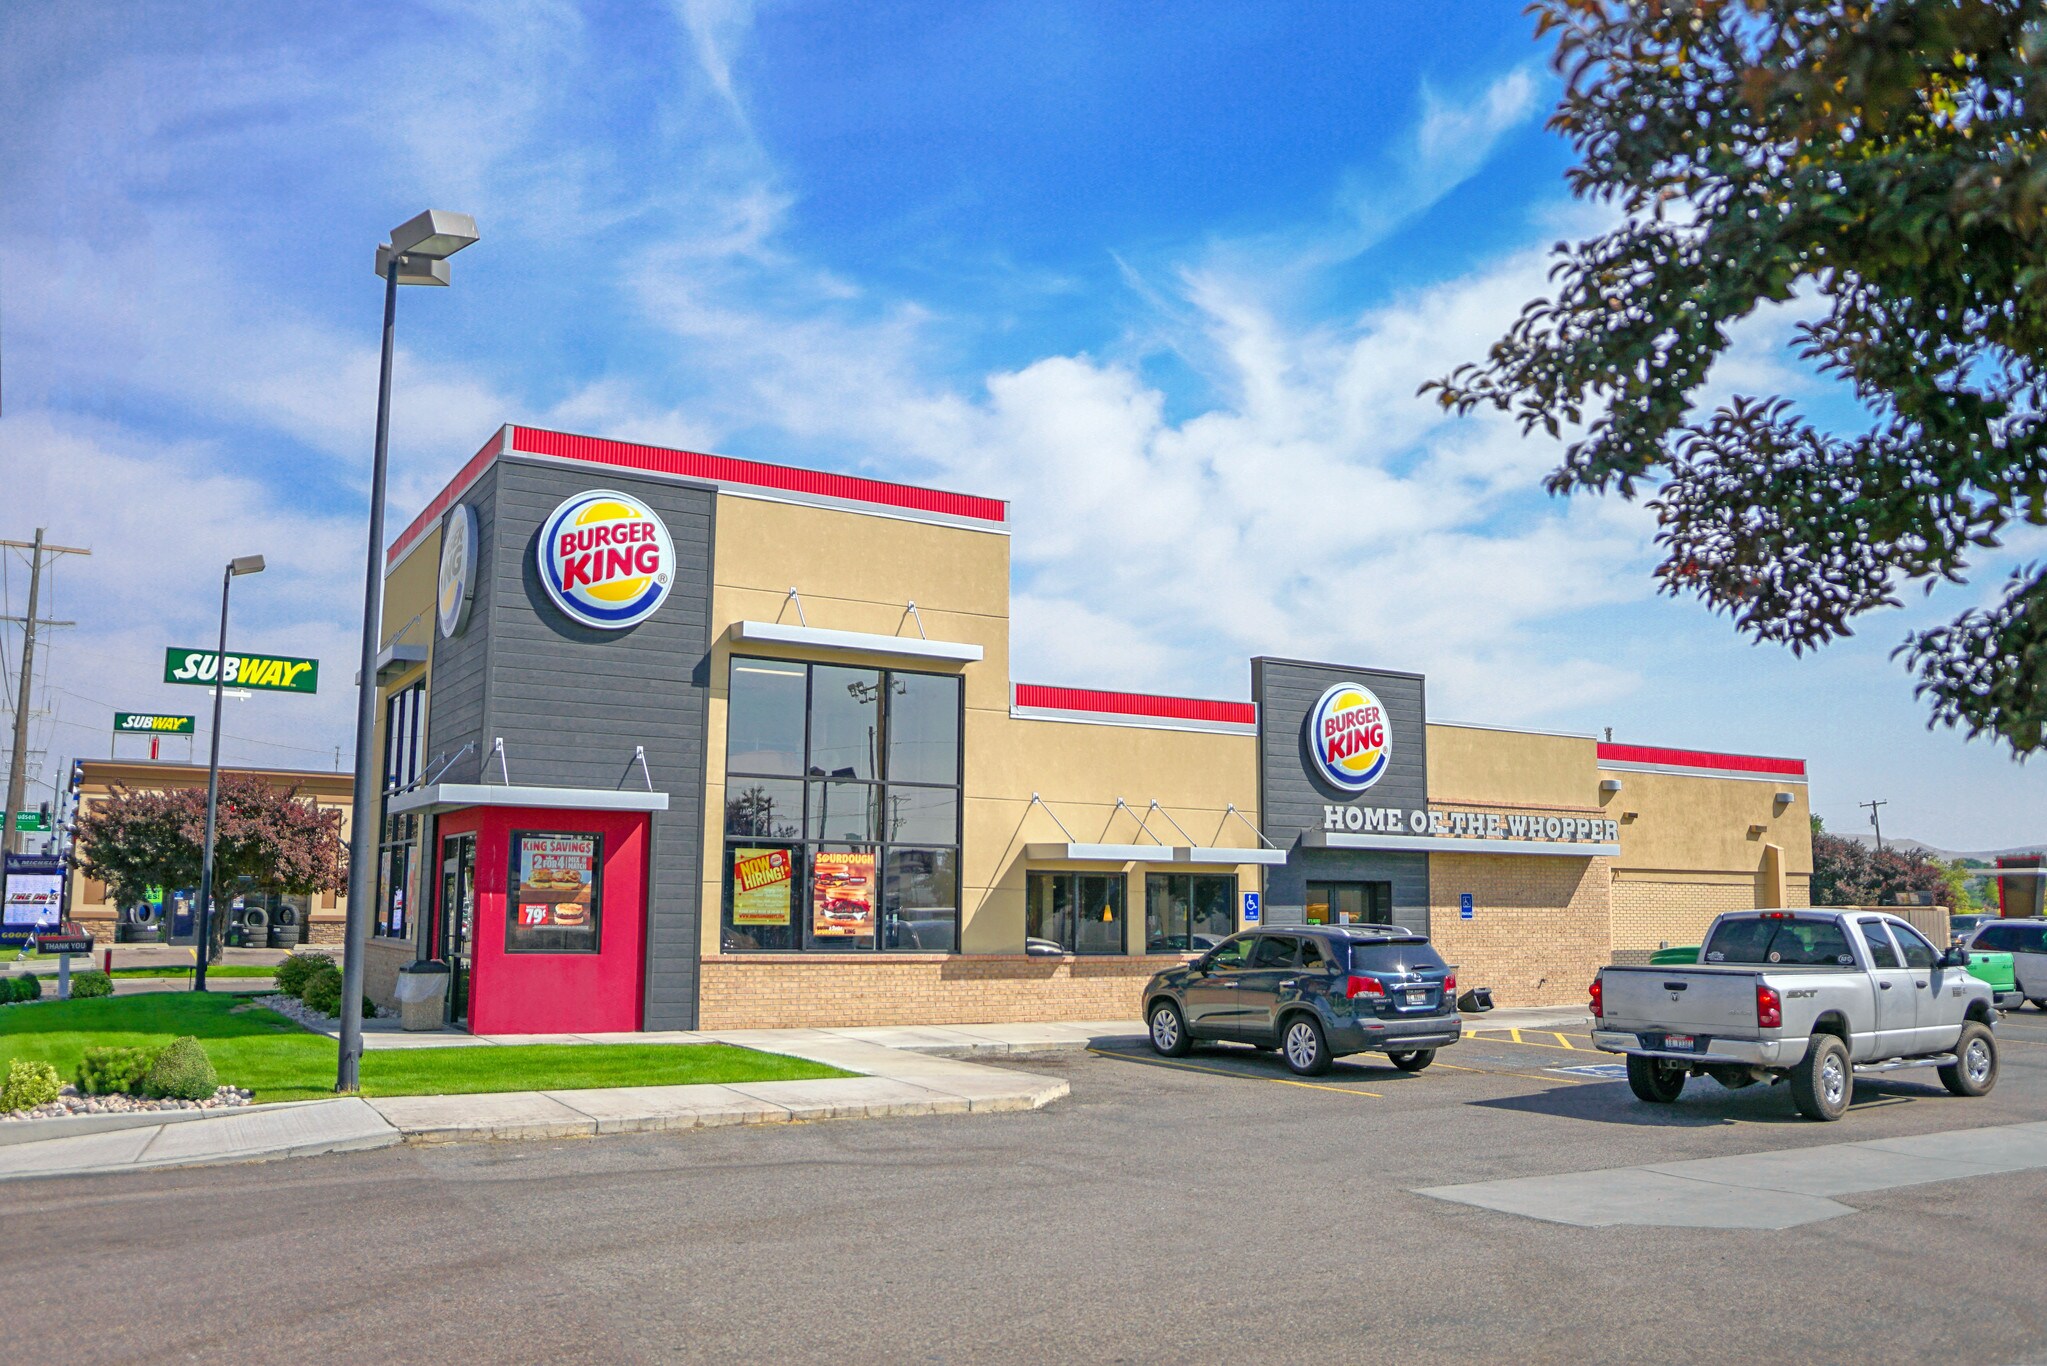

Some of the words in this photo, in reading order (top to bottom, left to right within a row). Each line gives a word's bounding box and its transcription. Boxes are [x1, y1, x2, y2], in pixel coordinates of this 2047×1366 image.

[560, 522, 656, 558] BURGER
[561, 543, 660, 592] KING
[173, 653, 312, 687] SUBWAY
[122, 715, 188, 731] SUBWAY
[1325, 706, 1381, 738] BURGER
[1326, 723, 1384, 764] KING
[1324, 805, 1402, 832] HOME
[1410, 810, 1444, 834] OF
[1450, 812, 1501, 836] THE
[1508, 815, 1620, 841] WHOPPER
[523, 840, 548, 851] KING
[533, 855, 543, 869] 2
[543, 860, 557, 868] FOR
[740, 855, 770, 876] NOW
[816, 853, 874, 865] SOURDOUGH
[743, 865, 786, 890] HIRING!
[1786, 989, 1818, 999] SXT
